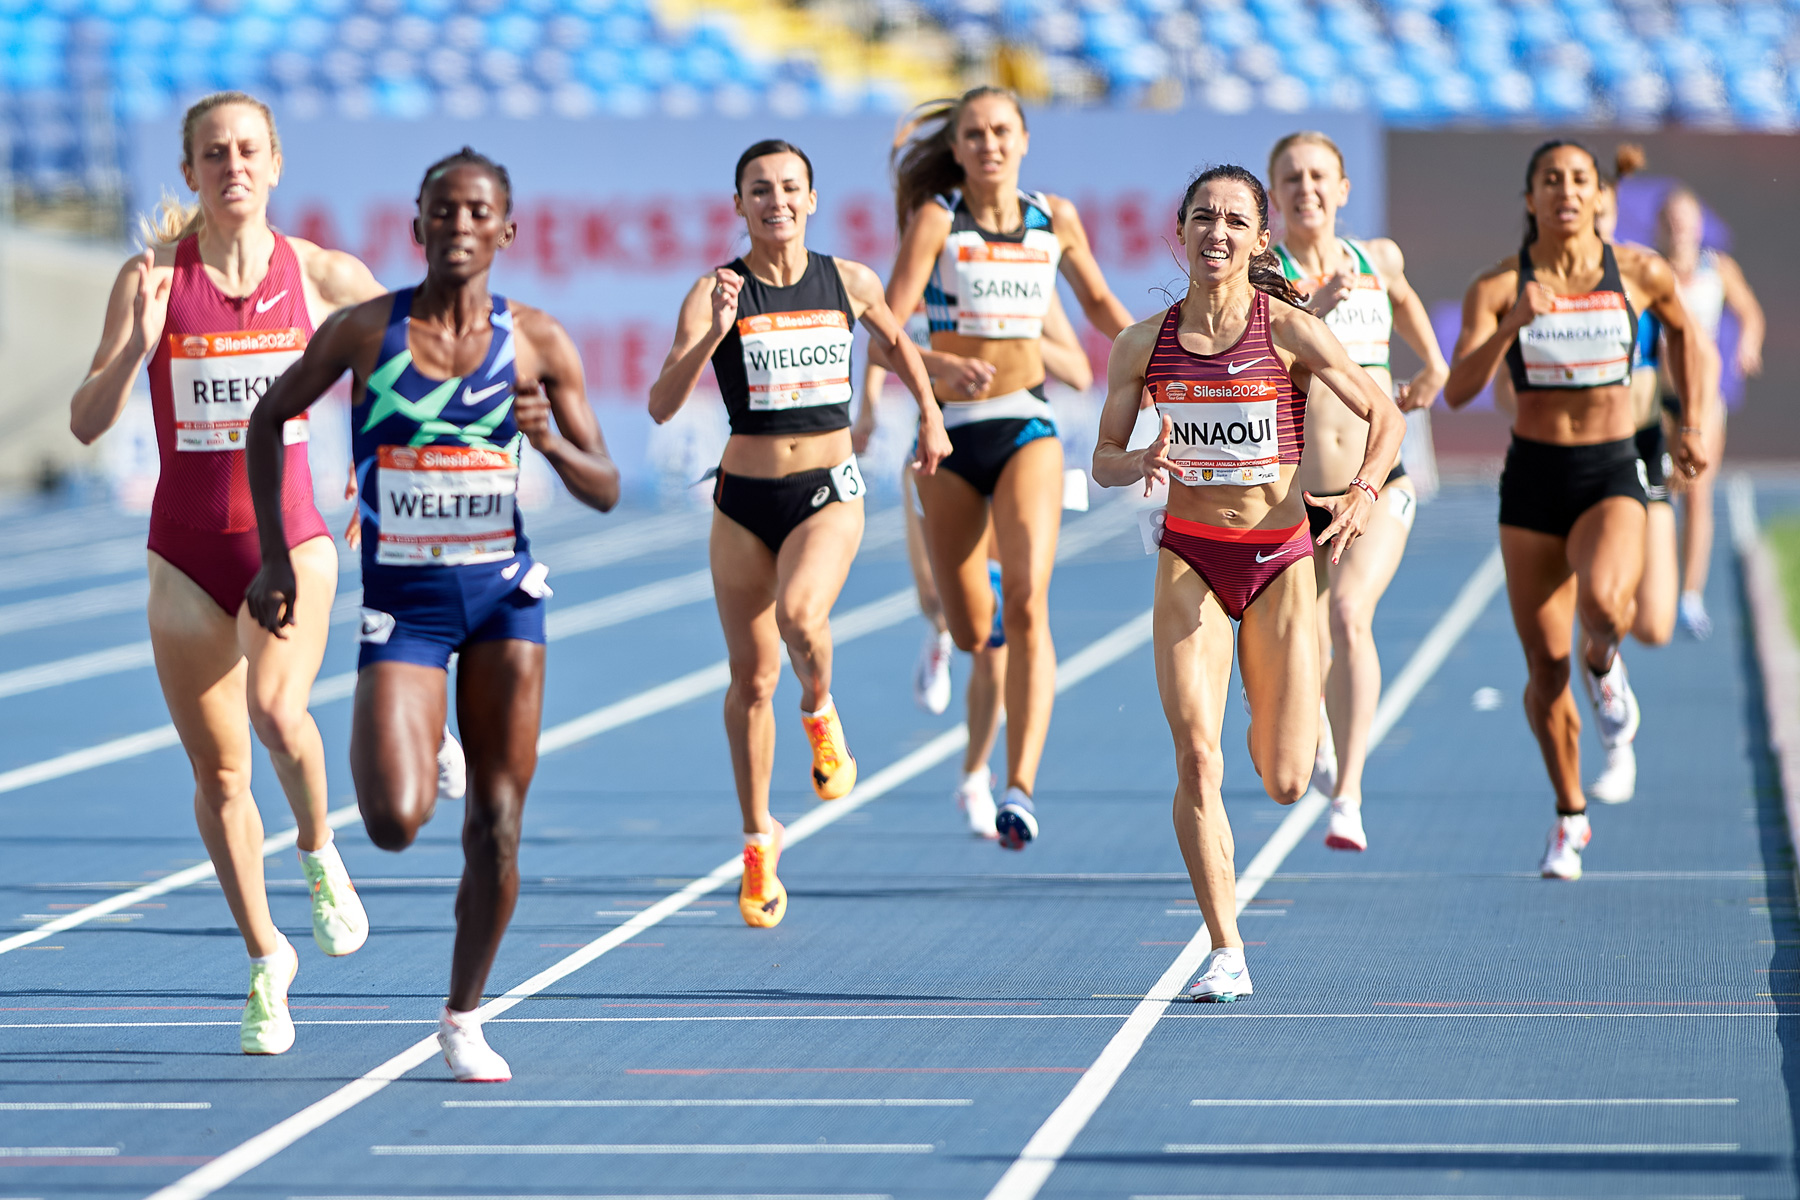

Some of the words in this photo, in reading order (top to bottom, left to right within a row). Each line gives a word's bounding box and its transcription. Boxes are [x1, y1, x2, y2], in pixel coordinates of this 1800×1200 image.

[972, 279, 1042, 299] SARNA
[213, 332, 296, 352] Silesia2022
[749, 343, 847, 371] WIELGOSZ
[192, 376, 281, 404] REEKI
[1193, 384, 1268, 397] Silesia2022
[843, 464, 858, 495] 3
[390, 490, 502, 518] WELTEJI
[1399, 489, 1411, 515] 7
[1149, 509, 1167, 547] 8
